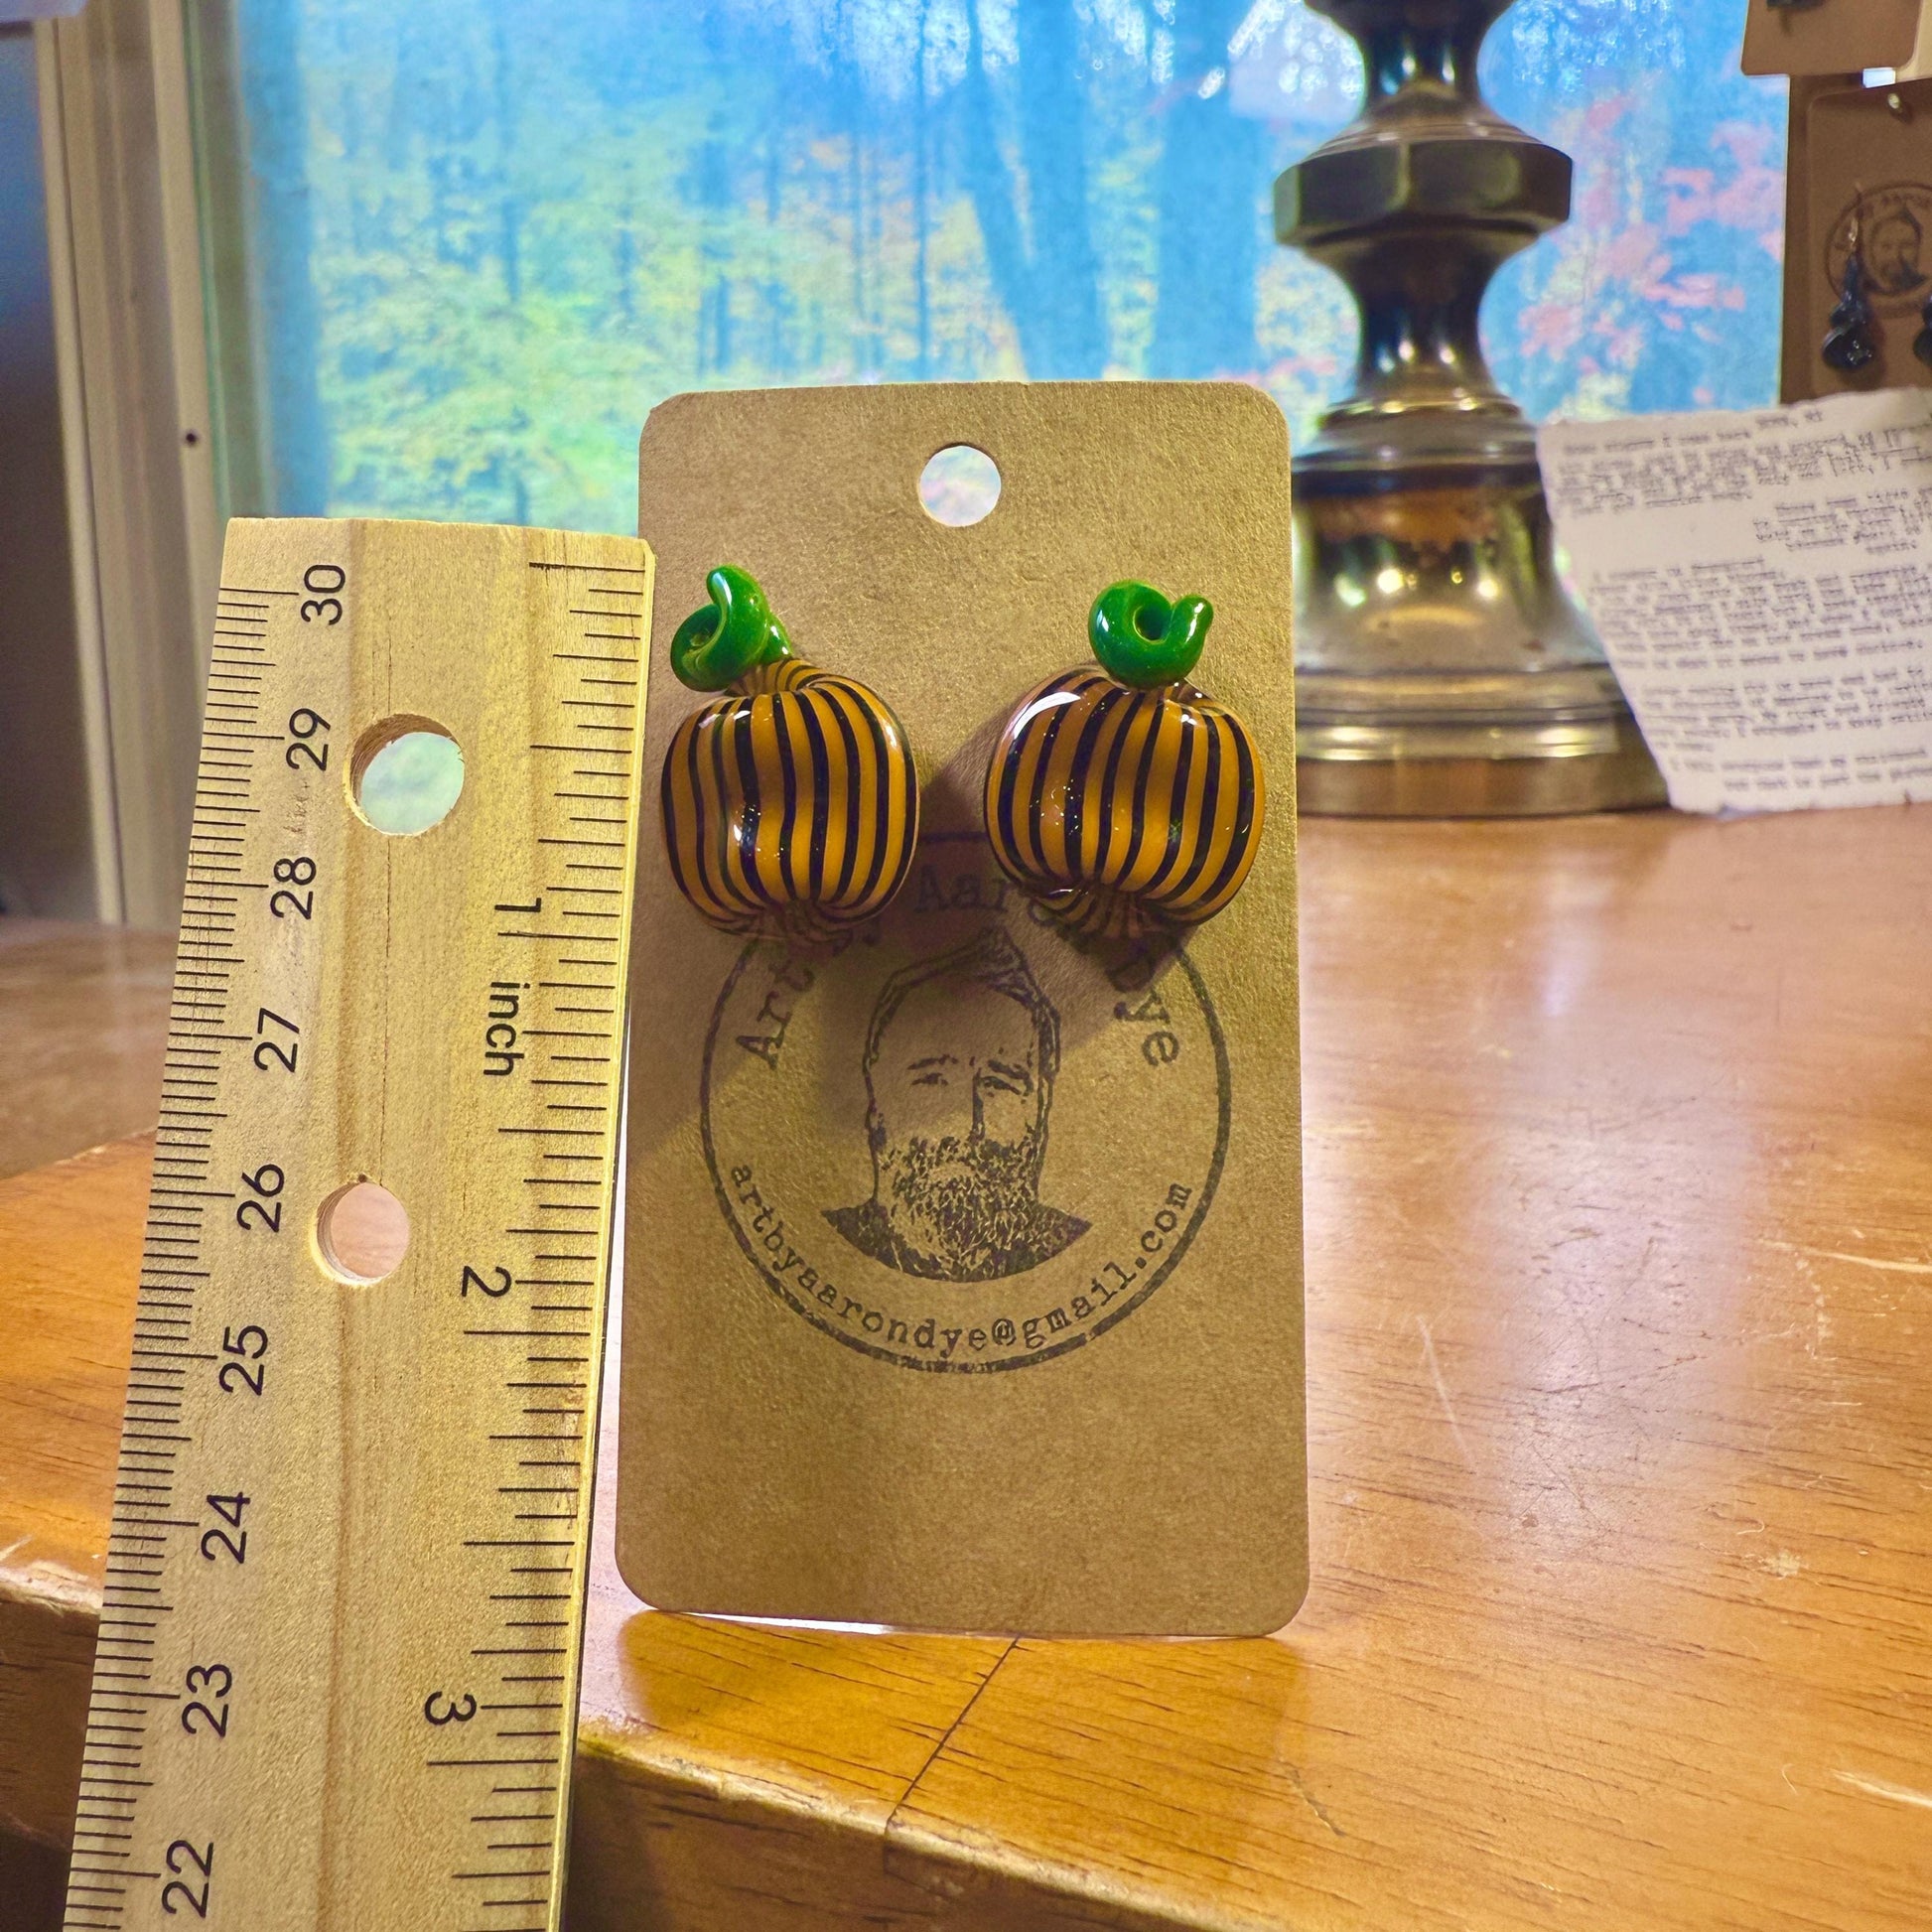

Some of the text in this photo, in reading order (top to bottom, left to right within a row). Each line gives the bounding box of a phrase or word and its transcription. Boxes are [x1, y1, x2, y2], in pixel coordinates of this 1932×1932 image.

[300, 563, 346, 626] 30
[285, 708, 332, 770] 29
[270, 856, 317, 919] 28
[483, 897, 542, 1077] 1 inch
[736, 960, 815, 1070] Art
[253, 1007, 300, 1073] 27
[236, 1164, 285, 1233] 26
[461, 1265, 512, 1298] 2
[730, 1163, 1193, 1357] artbyaarondye@gmail.com
[218, 1324, 268, 1396] 25
[200, 1490, 251, 1565] 24
[181, 1663, 233, 1737] 23
[423, 1690, 478, 1726] 3
[161, 1839, 214, 1918] 22
